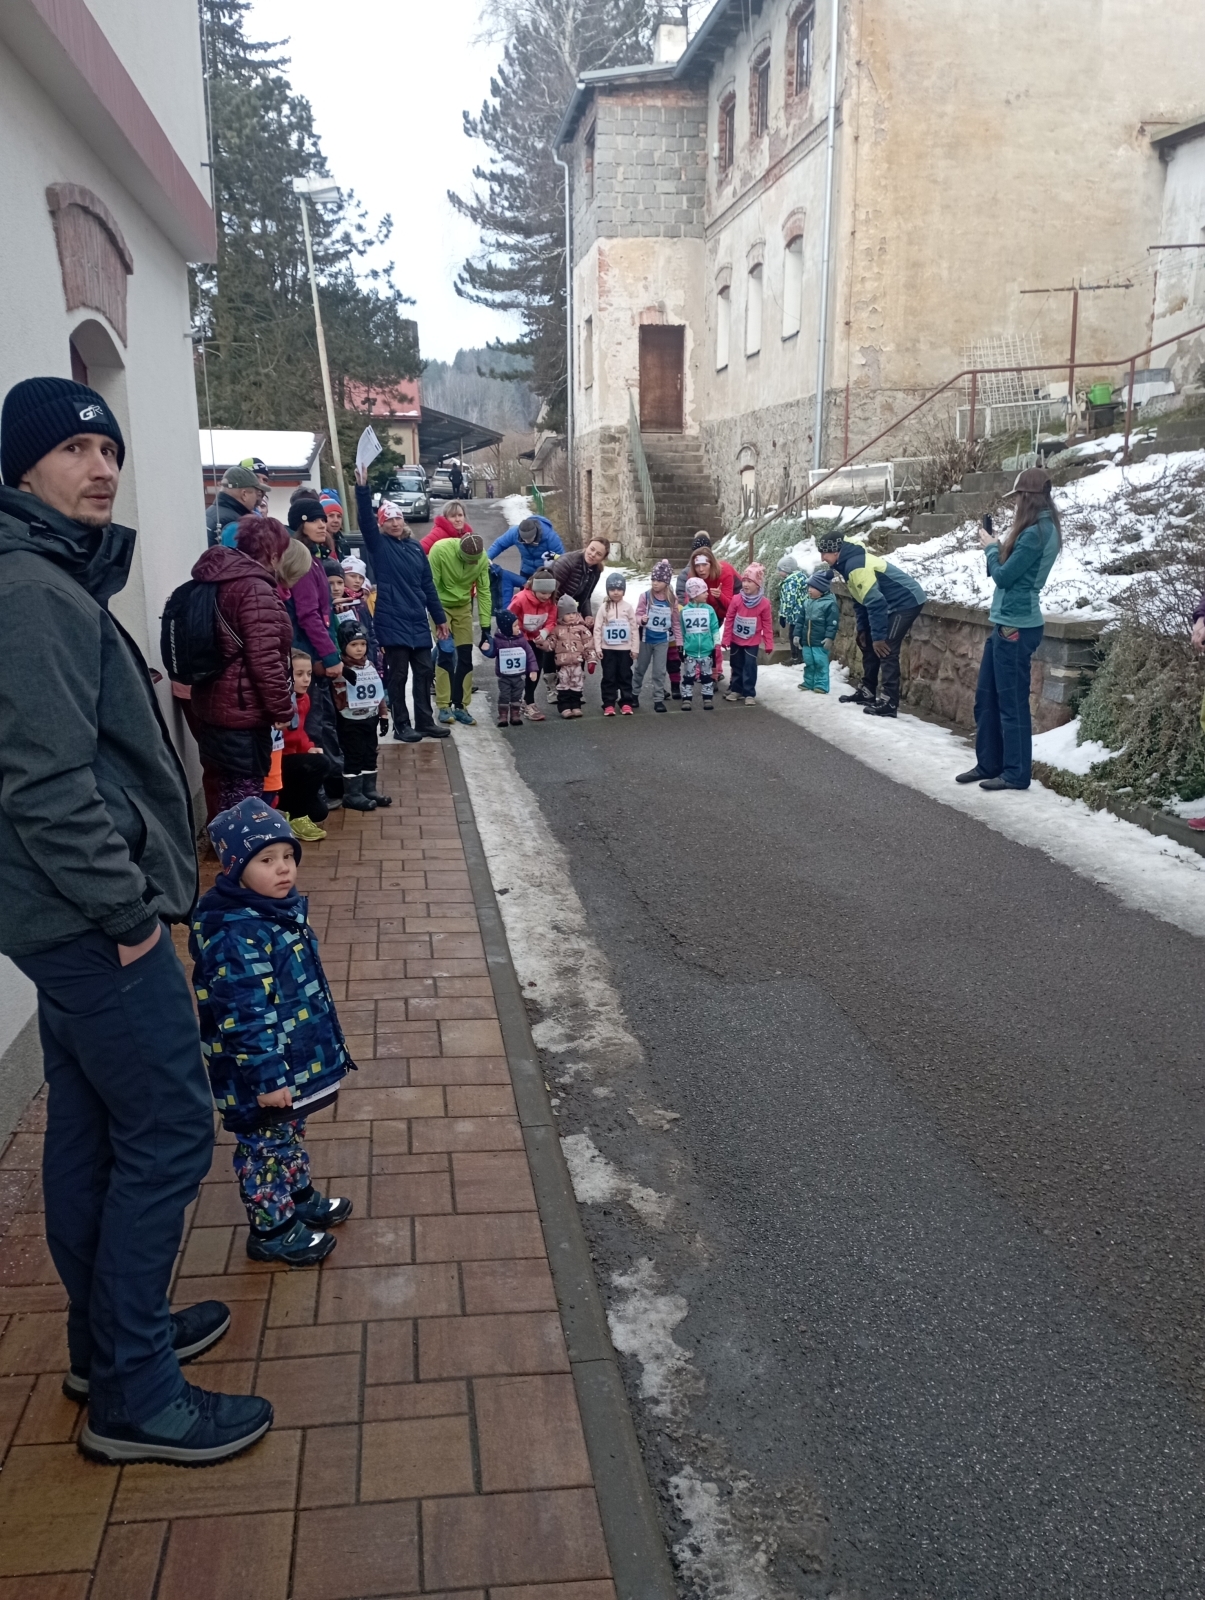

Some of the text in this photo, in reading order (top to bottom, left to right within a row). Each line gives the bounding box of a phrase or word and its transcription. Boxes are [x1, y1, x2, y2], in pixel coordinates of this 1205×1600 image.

[652, 616, 666, 627] 64
[685, 617, 707, 628] 242
[606, 629, 627, 639] 150
[736, 624, 750, 635] 95
[169, 619, 179, 674] SKECHERS
[506, 658, 521, 669] 93
[356, 684, 377, 700] 89
